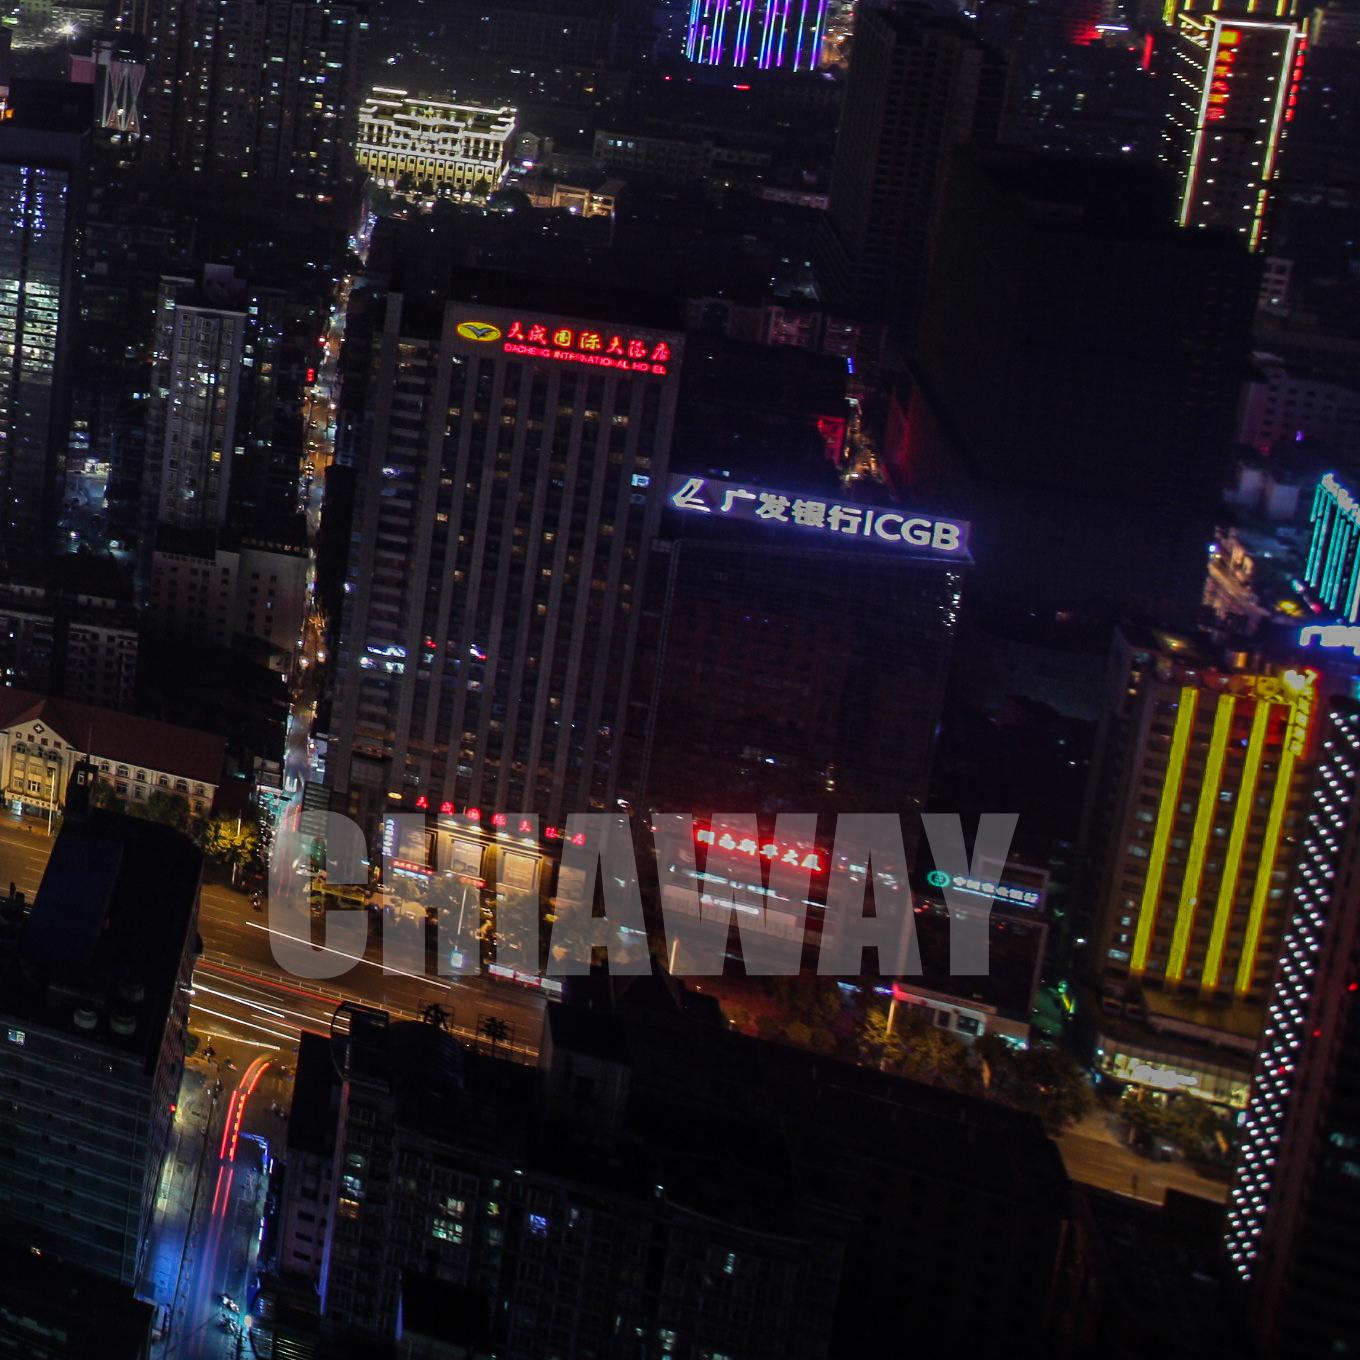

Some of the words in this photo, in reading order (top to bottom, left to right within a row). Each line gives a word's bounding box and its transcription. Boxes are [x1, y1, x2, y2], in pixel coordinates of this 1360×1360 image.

[503, 342, 551, 357] DACHEG
[632, 362, 667, 375] HOEL
[507, 322, 671, 361] 大成国际大酒店
